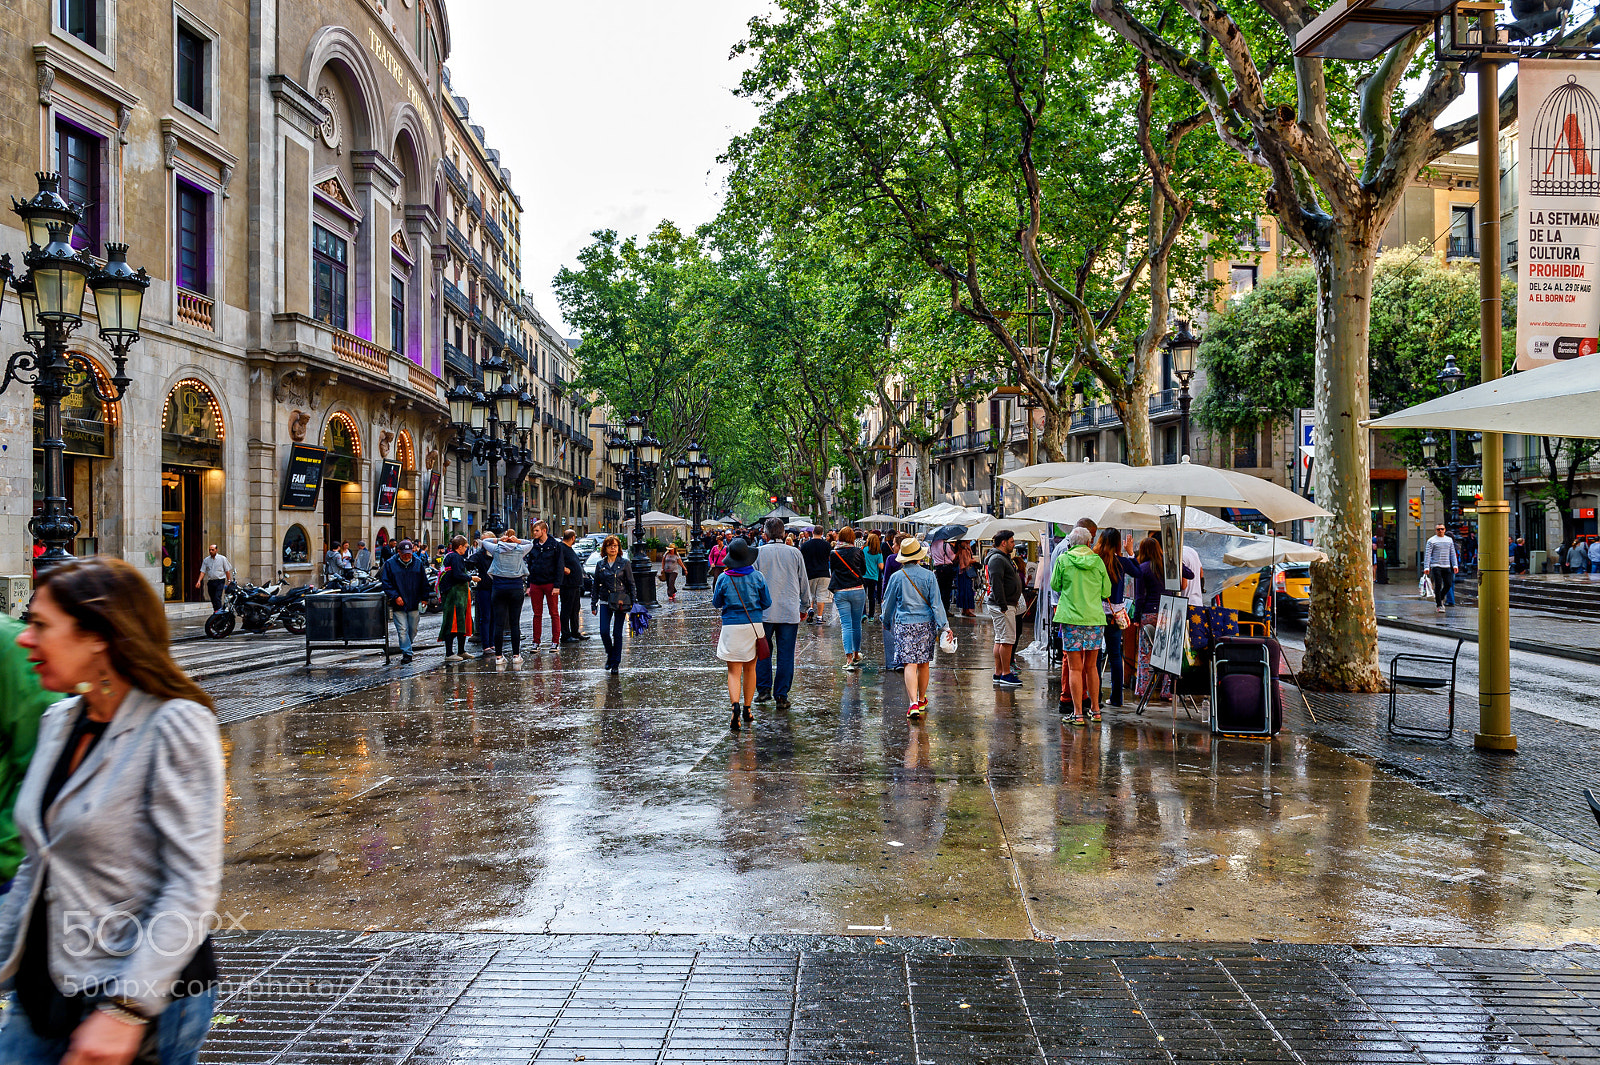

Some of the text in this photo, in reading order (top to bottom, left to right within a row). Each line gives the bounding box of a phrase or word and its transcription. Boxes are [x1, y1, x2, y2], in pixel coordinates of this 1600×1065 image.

[368, 27, 404, 88] TEATRE
[1529, 211, 1600, 226] LA SETMANA
[1529, 229, 1562, 243] DE LA
[1529, 246, 1580, 260] CULTURA
[1529, 263, 1585, 278] PROHIBIDA
[1529, 282, 1592, 293] DEL 24 AL 29 DE MAIG
[1529, 293, 1534, 302] A
[1535, 293, 1544, 302] EL
[1545, 293, 1564, 303] BORN
[291, 473, 306, 484] FAM
